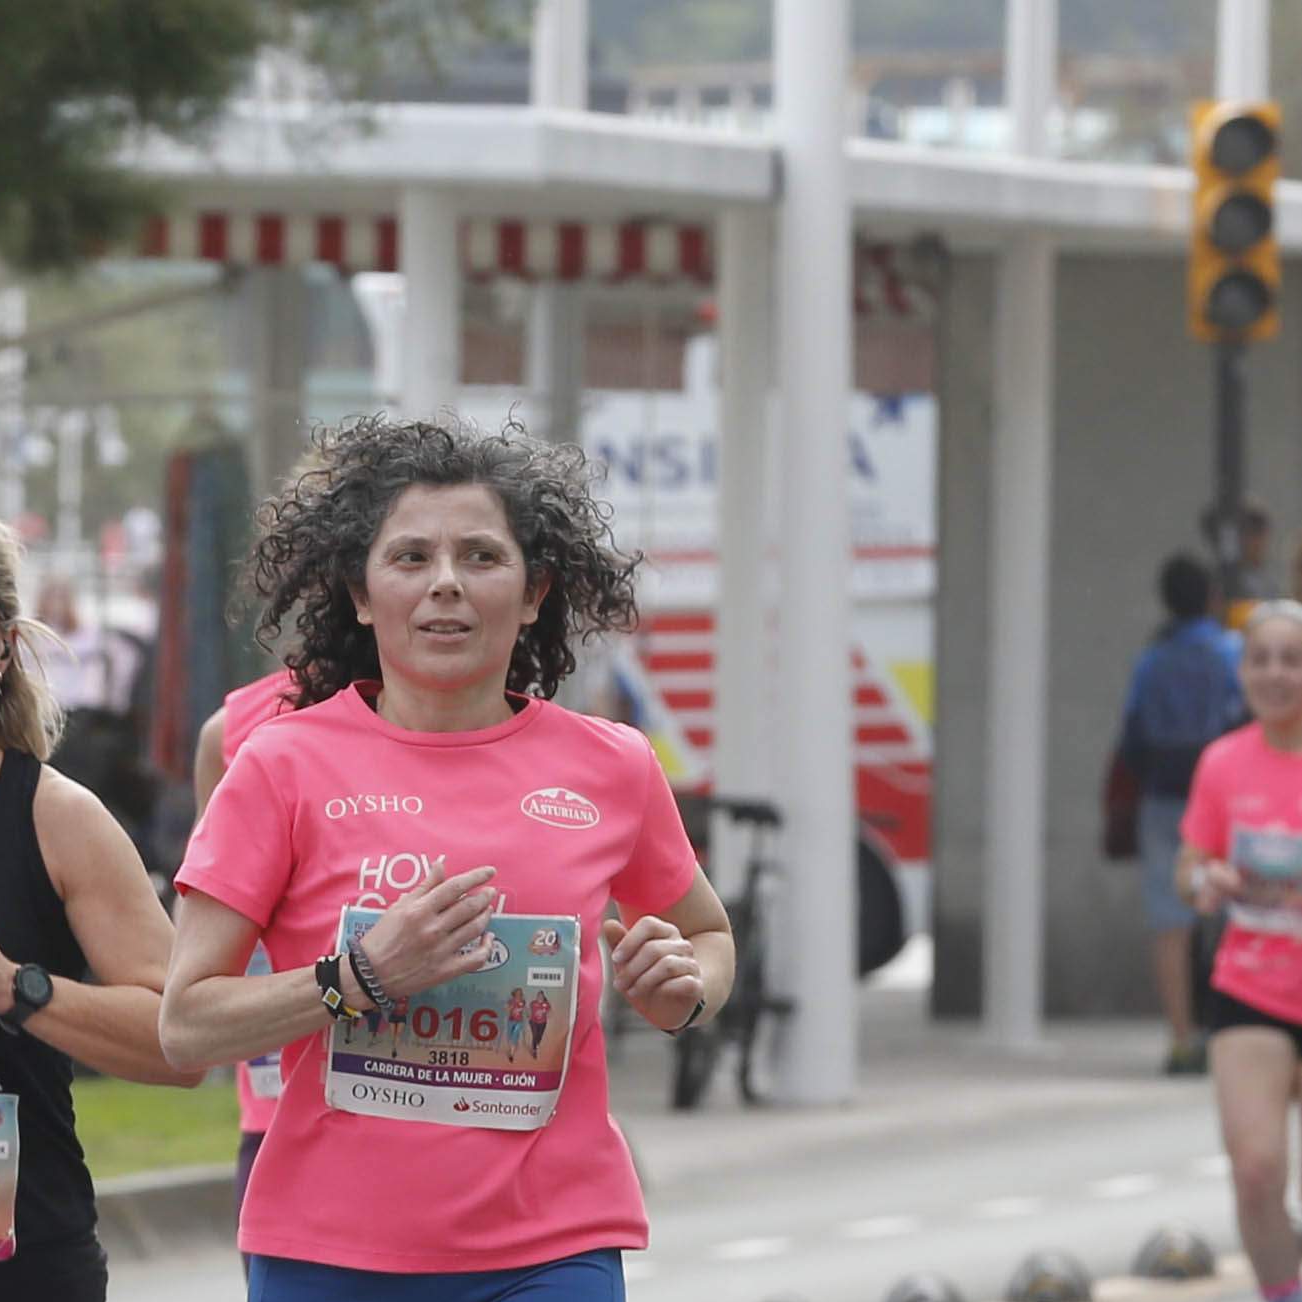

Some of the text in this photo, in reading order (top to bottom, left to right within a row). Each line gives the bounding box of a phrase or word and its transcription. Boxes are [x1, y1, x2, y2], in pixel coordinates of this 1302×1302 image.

[324, 794, 423, 819] OYSHO
[528, 799, 595, 824] ASTURIANA
[534, 930, 557, 946] 20
[411, 1006, 500, 1042] 016
[428, 1051, 470, 1066] 3818
[364, 1060, 536, 1087] CARRERA DE LA MUJER GIJÓN
[352, 1082, 542, 1116] OYSHO Santander
